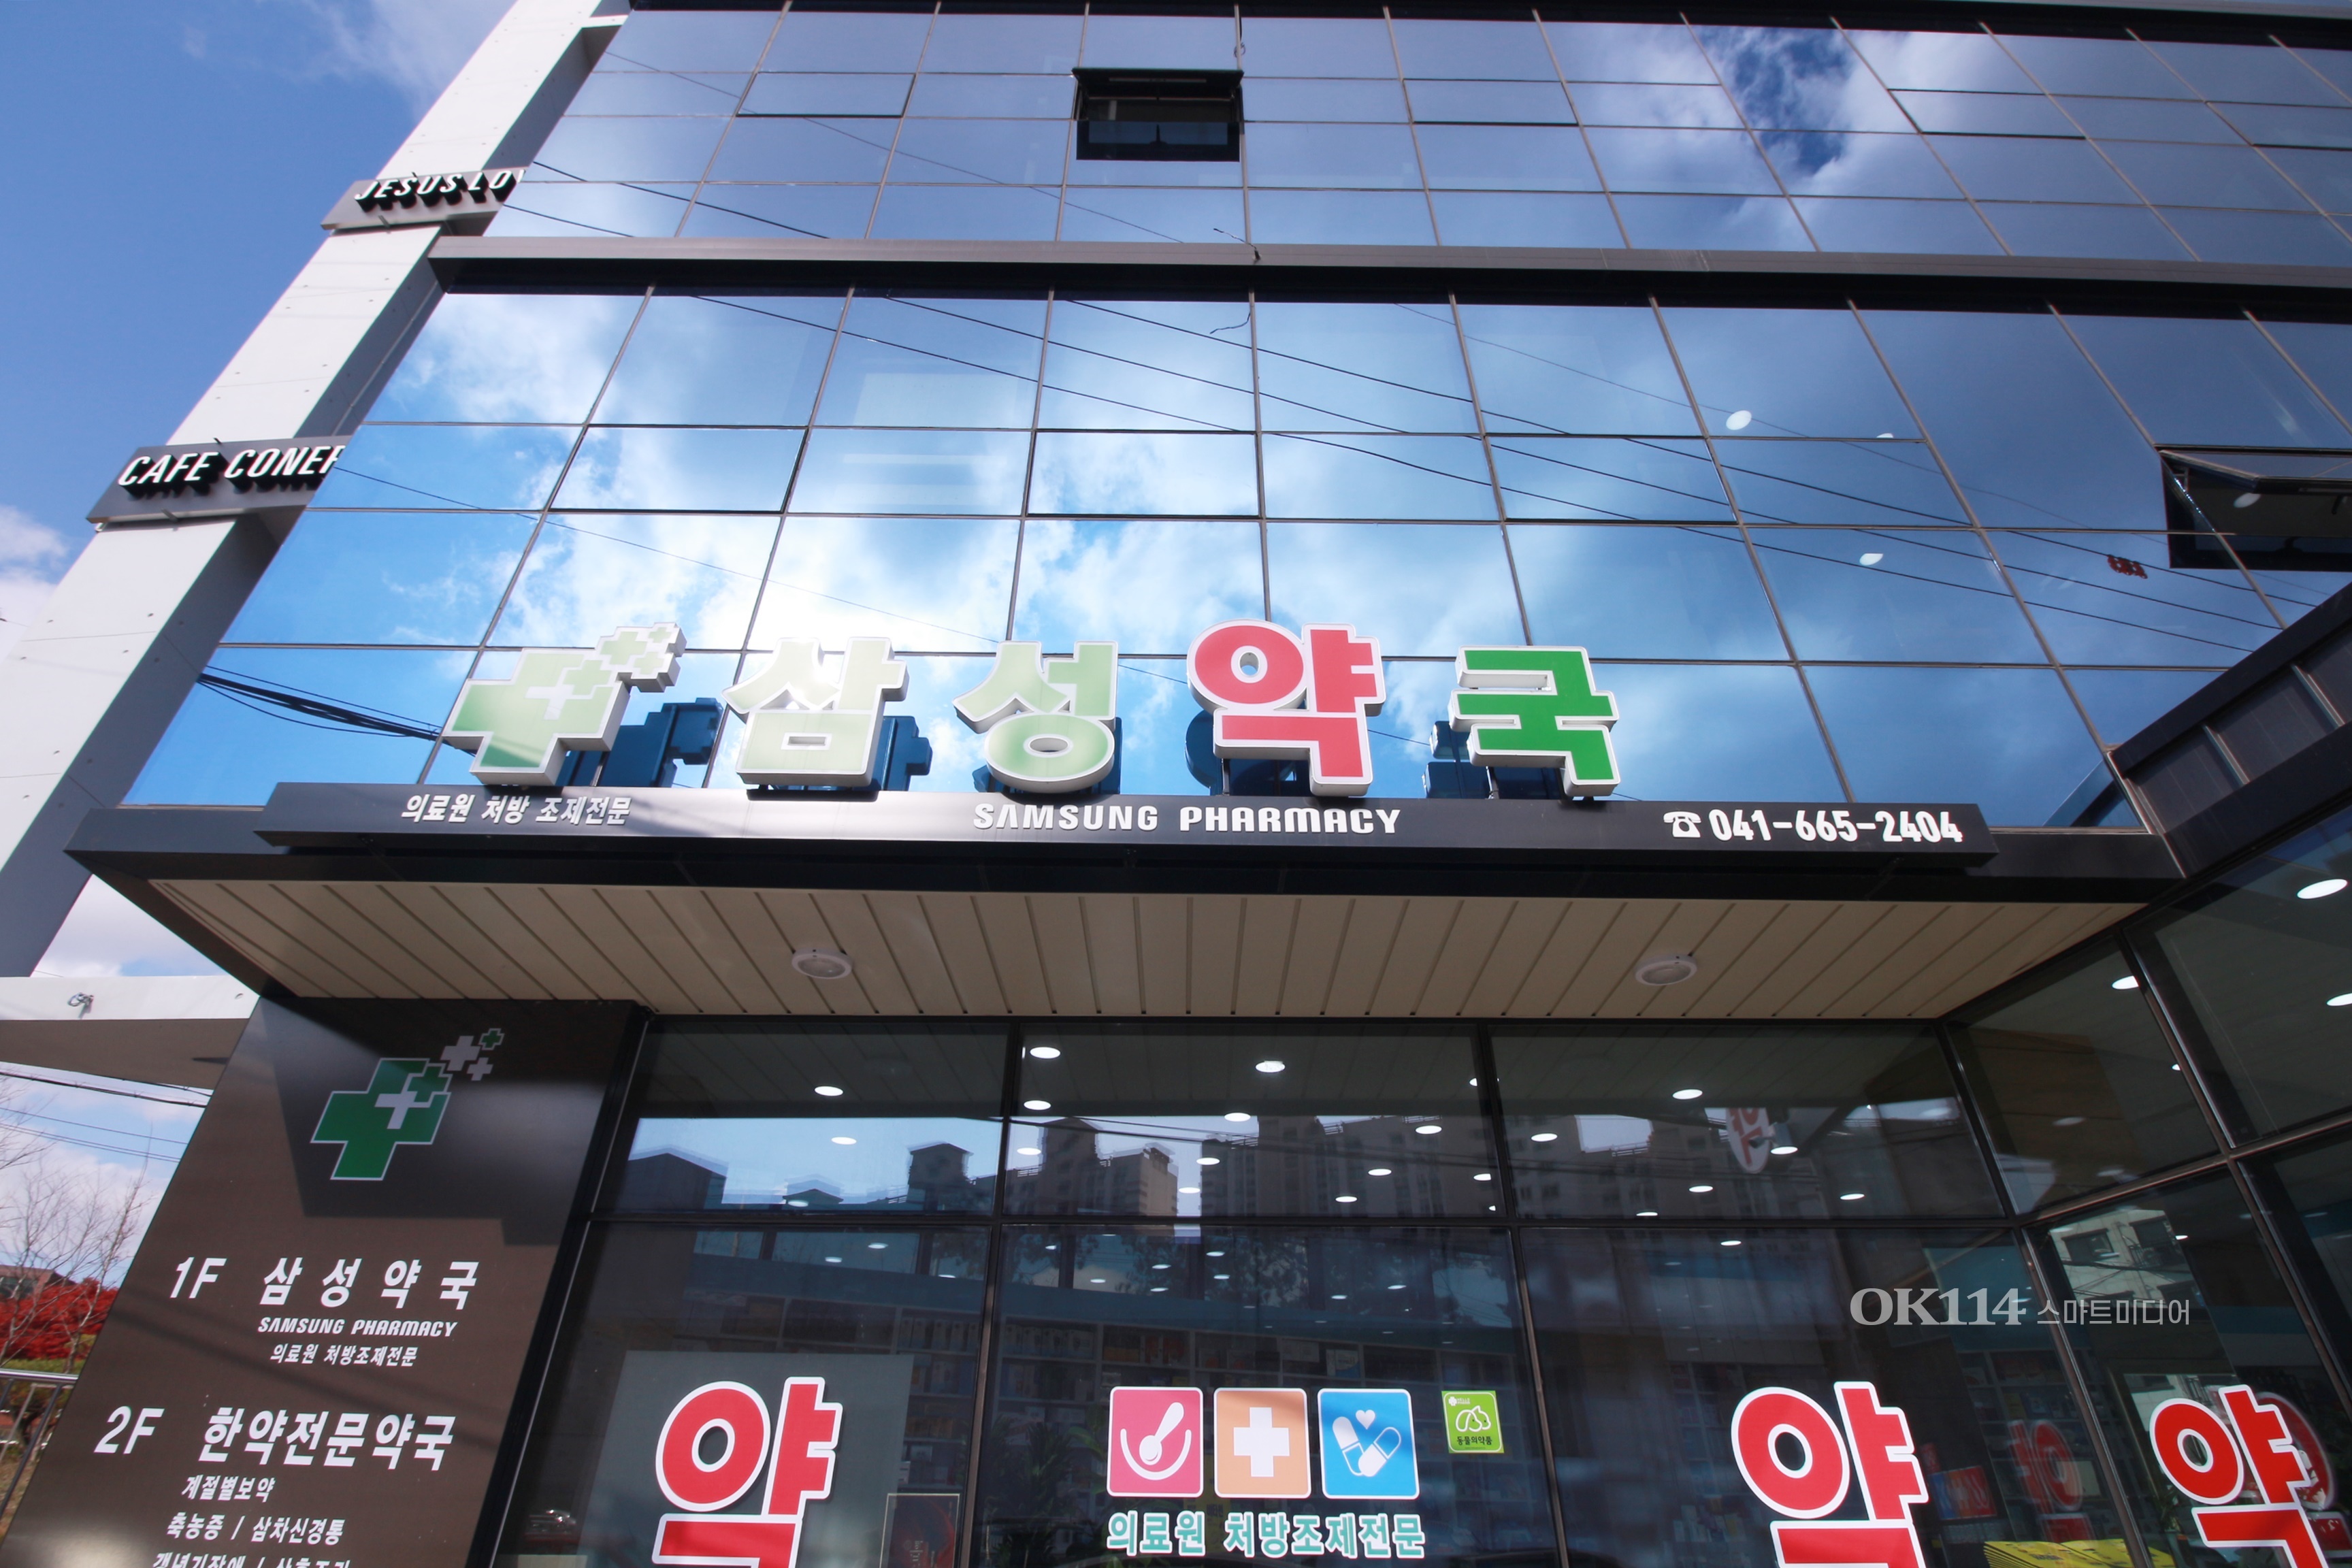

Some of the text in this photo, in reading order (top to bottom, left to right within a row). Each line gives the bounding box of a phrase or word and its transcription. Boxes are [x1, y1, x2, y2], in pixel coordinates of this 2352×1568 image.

[354, 173, 463, 200] JESUS
[118, 452, 219, 485] CAFE
[401, 793, 633, 826] 의료원 처방 조제전문
[973, 804, 1401, 834] SAMSUNG PHARMACY
[1708, 808, 1963, 843] 041-665-2404
[170, 1257, 227, 1298] 1F
[258, 1316, 458, 1337] SAMSUNG PHARMACY
[270, 1343, 418, 1367] 의료원 처방조제전문
[94, 1406, 456, 1471] 2F 한약전문약국
[1457, 1436, 1492, 1446] 동물의약품
[181, 1474, 276, 1503] 계절별보약
[652, 1376, 843, 1568] 약
[1731, 1381, 1929, 1568] 약
[2149, 1384, 2330, 1568] 약
[167, 1512, 225, 1540] 축농증
[251, 1516, 345, 1546] 삼차신경통
[1107, 1510, 1425, 1559] 의료원 처방조제전문
